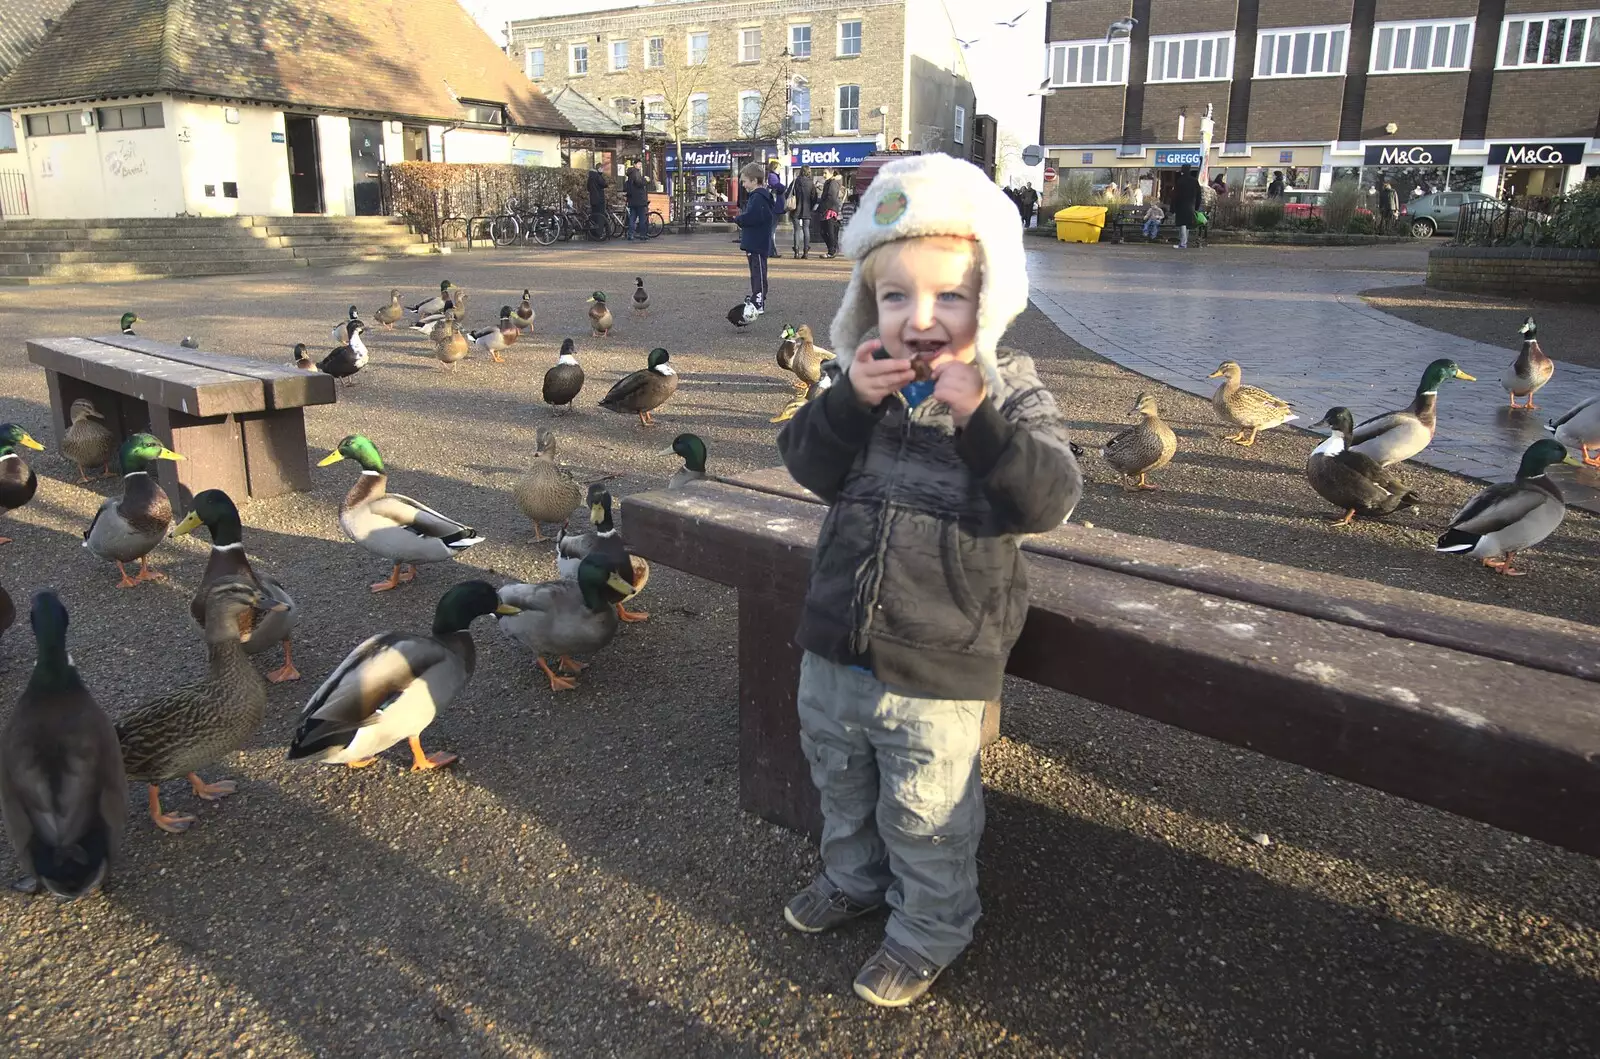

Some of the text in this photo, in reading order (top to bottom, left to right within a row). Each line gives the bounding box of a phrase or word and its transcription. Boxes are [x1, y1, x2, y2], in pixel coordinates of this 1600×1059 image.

[684, 149, 734, 165] Martin's
[801, 147, 841, 164] Break
[1167, 154, 1200, 164] GREGG
[1380, 147, 1433, 164] M&Co.
[1505, 146, 1563, 164] M&Co.
